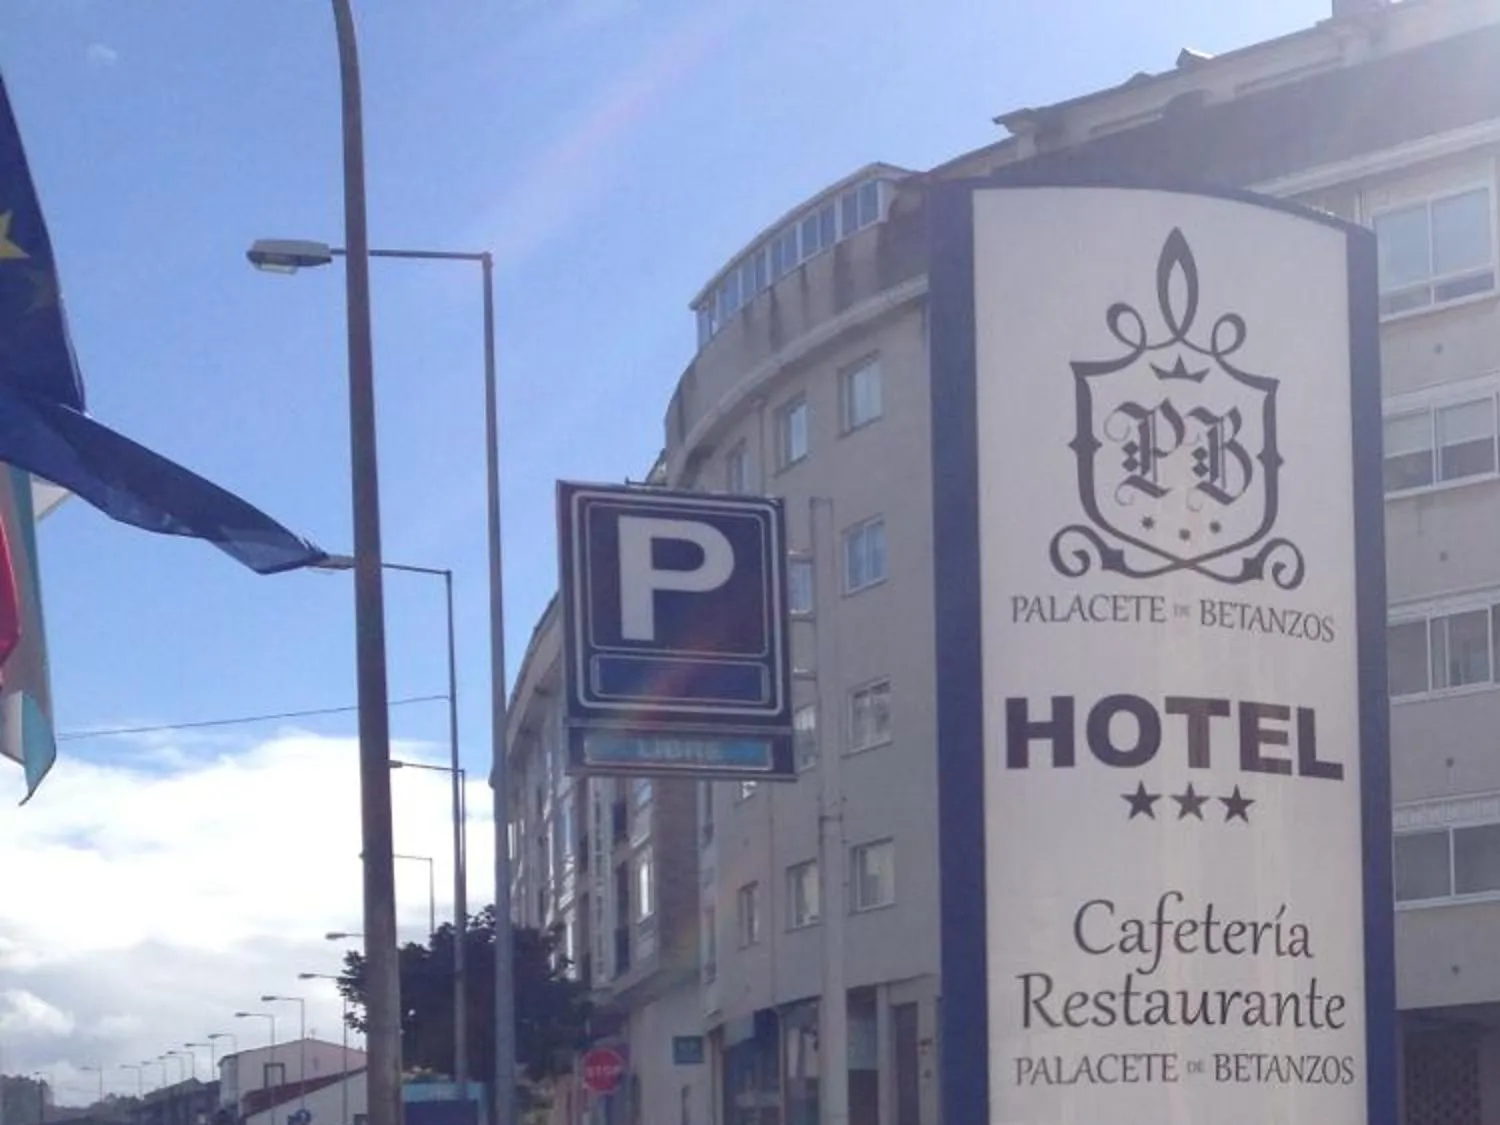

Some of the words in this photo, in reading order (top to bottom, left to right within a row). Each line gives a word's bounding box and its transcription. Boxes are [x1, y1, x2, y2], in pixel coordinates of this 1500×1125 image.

[617, 514, 735, 642] P
[1011, 595, 1167, 623] PALACETE
[1200, 599, 1336, 643] BETANZOS
[1005, 693, 1345, 781] HOTEL
[1073, 891, 1315, 975] Cafetería
[1016, 972, 1346, 1030] Restaurante
[1014, 1053, 1179, 1086] PALACETE
[1214, 1053, 1355, 1085] BETANZOS
